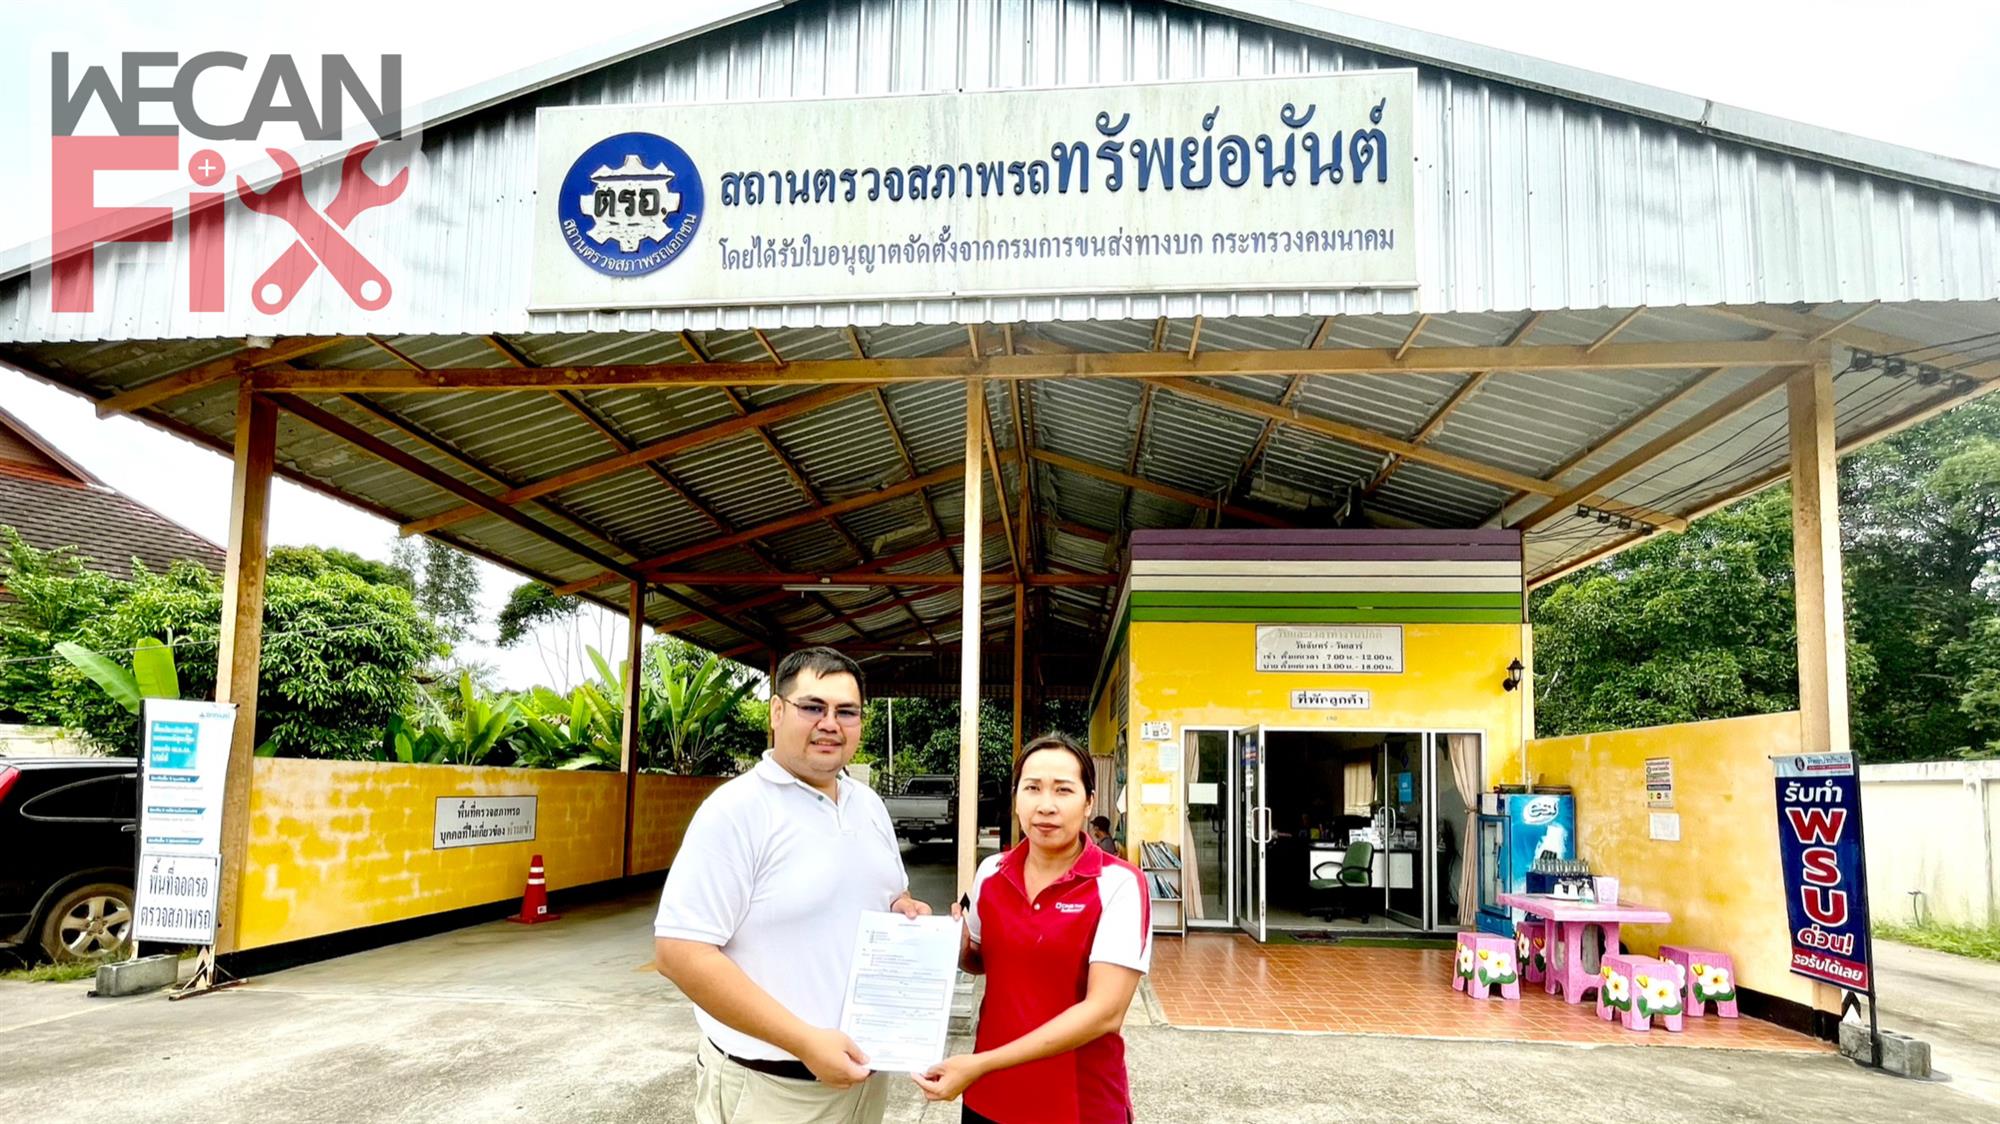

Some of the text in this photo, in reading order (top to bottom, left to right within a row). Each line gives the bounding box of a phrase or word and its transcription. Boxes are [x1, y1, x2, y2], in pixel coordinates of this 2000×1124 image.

[594, 187, 667, 217] ตรอ.
[563, 213, 697, 271] สถานตรวจสภาพรถเอกชน
[718, 225, 1395, 275] โดยได้รับใบอนุญาตจัดตั้งจากกรมการขนส่งทางบก กระทรวงคมนาคม
[1297, 690, 1364, 706] ที่พักลูกค้า
[1784, 779, 1843, 802] รับทำ
[141, 906, 211, 929] ตรวจสภาพรถ
[1797, 923, 1854, 956] ด่วน!
[1793, 953, 1863, 981] รอรับได้เลย
